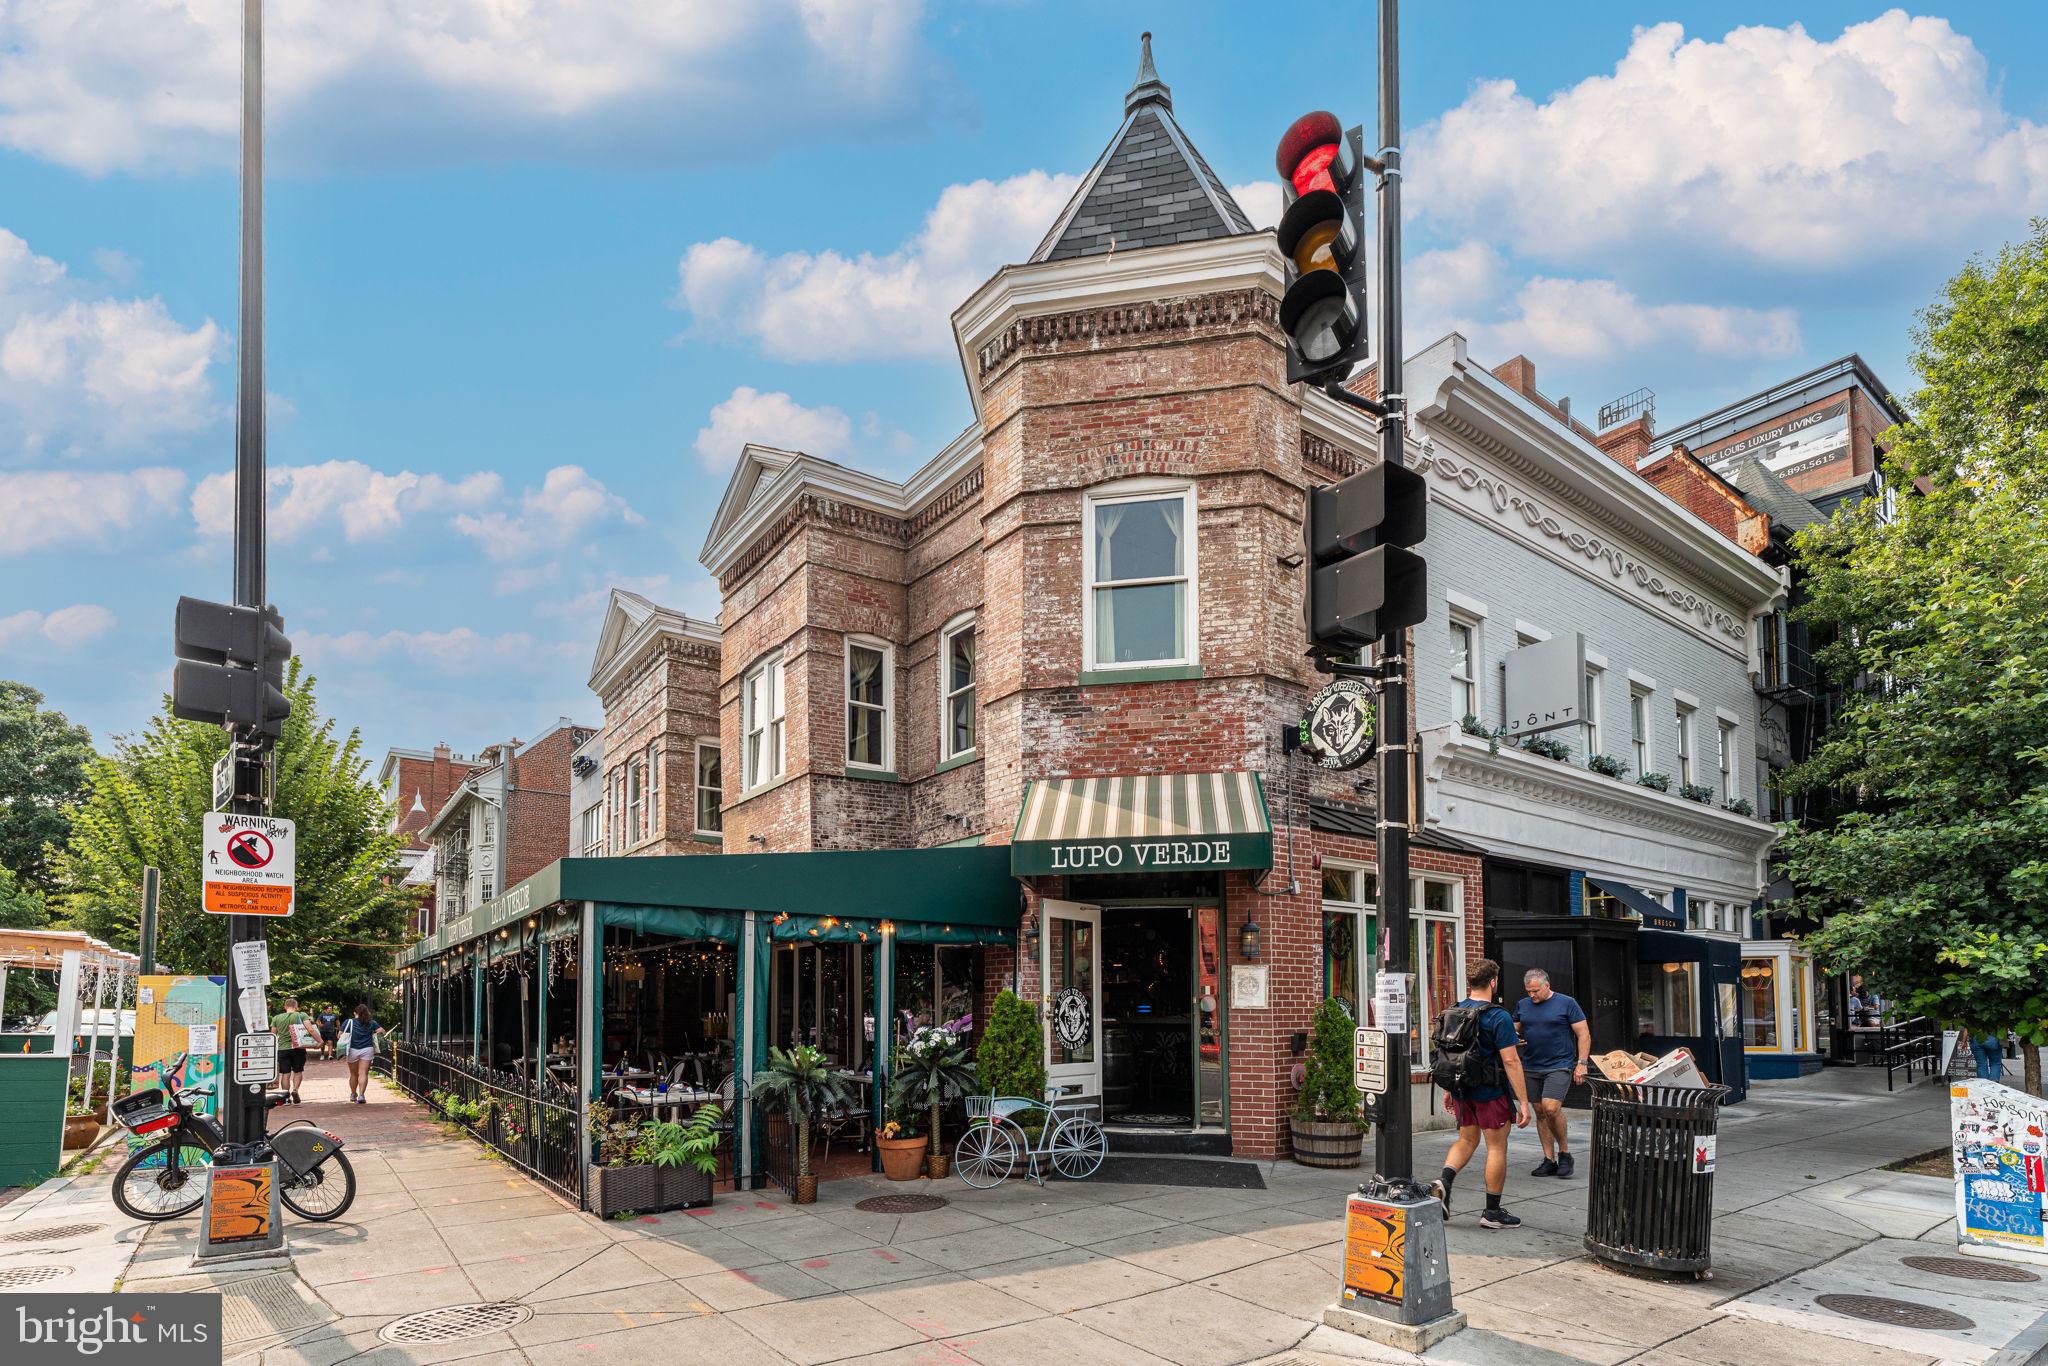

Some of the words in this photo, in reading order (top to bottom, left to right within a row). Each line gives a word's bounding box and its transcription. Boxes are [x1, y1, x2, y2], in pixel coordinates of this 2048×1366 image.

[1699, 452, 1718, 466] THE
[1719, 443, 1746, 459] LOUIS
[1748, 427, 1784, 448] LUXURY
[1788, 412, 1823, 432] LIVING
[1775, 453, 1836, 480] 6.893.5615
[1511, 707, 1573, 730] JÔNT
[224, 814, 276, 829] WARNING
[1051, 844, 1123, 868] LUPO
[1131, 841, 1231, 865] VERDE
[215, 869, 264, 878] NEIGHBORHOOD
[222, 884, 265, 892] NEIGHBORHOOD
[266, 886, 290, 894] REPORTS
[219, 903, 259, 911] METROPOLITAN
[506, 884, 530, 916] VERDE
[1058, 988, 1071, 1005] LUPO
[1072, 988, 1088, 1006] VERDE
